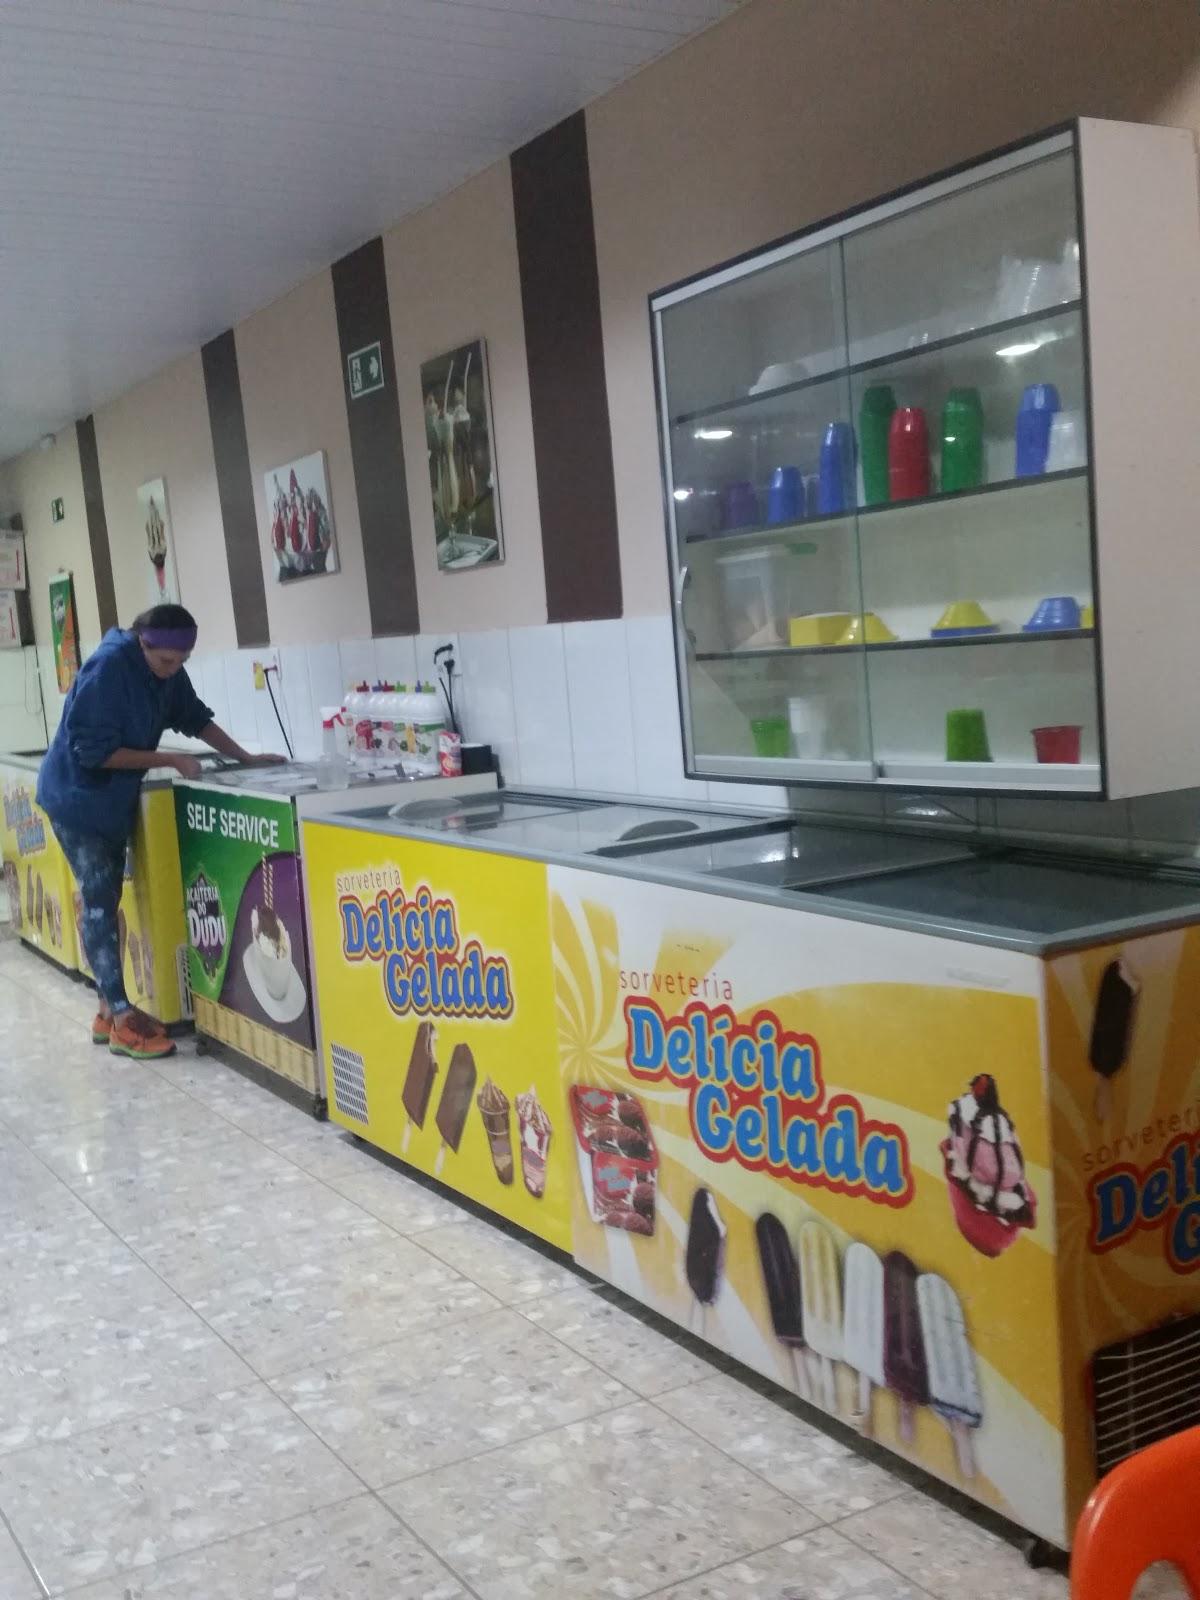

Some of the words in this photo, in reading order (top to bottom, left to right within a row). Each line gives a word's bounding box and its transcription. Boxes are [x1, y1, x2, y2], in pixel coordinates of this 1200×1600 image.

[186, 801, 217, 833] SELF
[219, 808, 279, 848] SERVICE
[336, 868, 401, 892] sorveteria
[187, 908, 227, 947] DUDU
[342, 894, 456, 954] Delícia
[386, 950, 510, 1010] Gelada
[620, 968, 734, 1001] sorveteria
[629, 1006, 818, 1100] Delícia
[695, 1083, 905, 1194] Gelada
